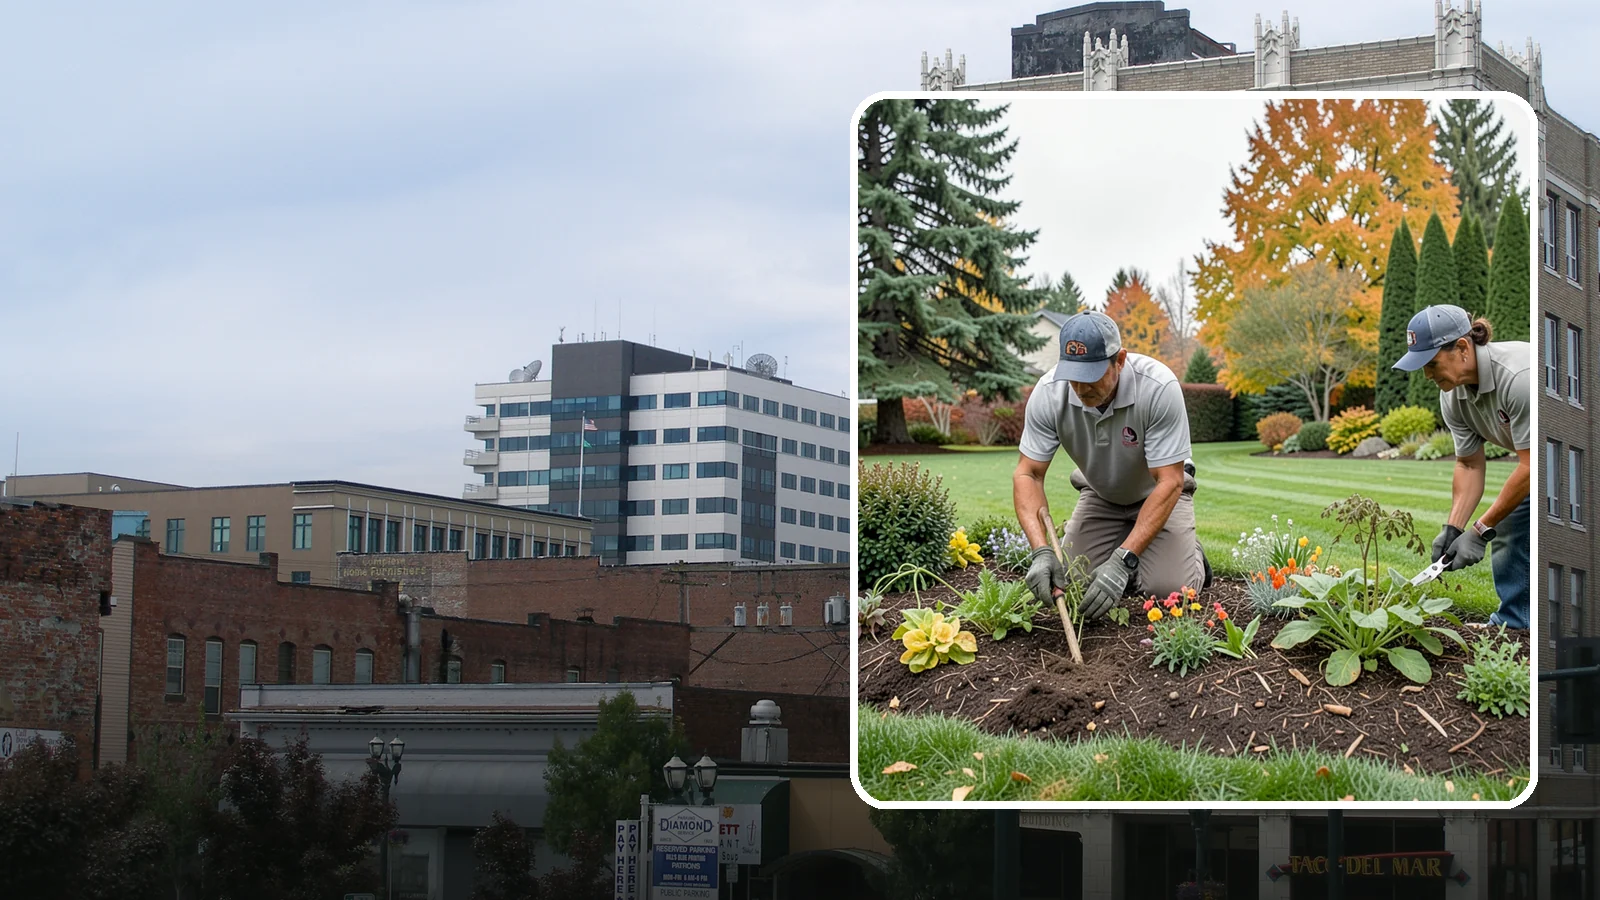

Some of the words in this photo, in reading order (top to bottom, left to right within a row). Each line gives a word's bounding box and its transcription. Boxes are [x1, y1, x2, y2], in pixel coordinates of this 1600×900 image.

[343, 567, 367, 577] Home
[370, 566, 427, 577] Furnishers
[660, 818, 713, 833] DIAMOND
[1022, 815, 1069, 828] BUILDING
[617, 825, 625, 852] PAY
[628, 824, 637, 852] PAY
[656, 845, 688, 853] RESERVED
[689, 846, 716, 854] PARKING
[721, 851, 739, 862] Soup
[671, 861, 701, 870] PATRONS
[1345, 856, 1384, 876] DEL
[1392, 857, 1442, 877] MAR
[616, 856, 625, 893] HERE
[627, 856, 636, 893] HERE
[660, 888, 682, 897] PUBLIC
[683, 889, 710, 898] PARKING
